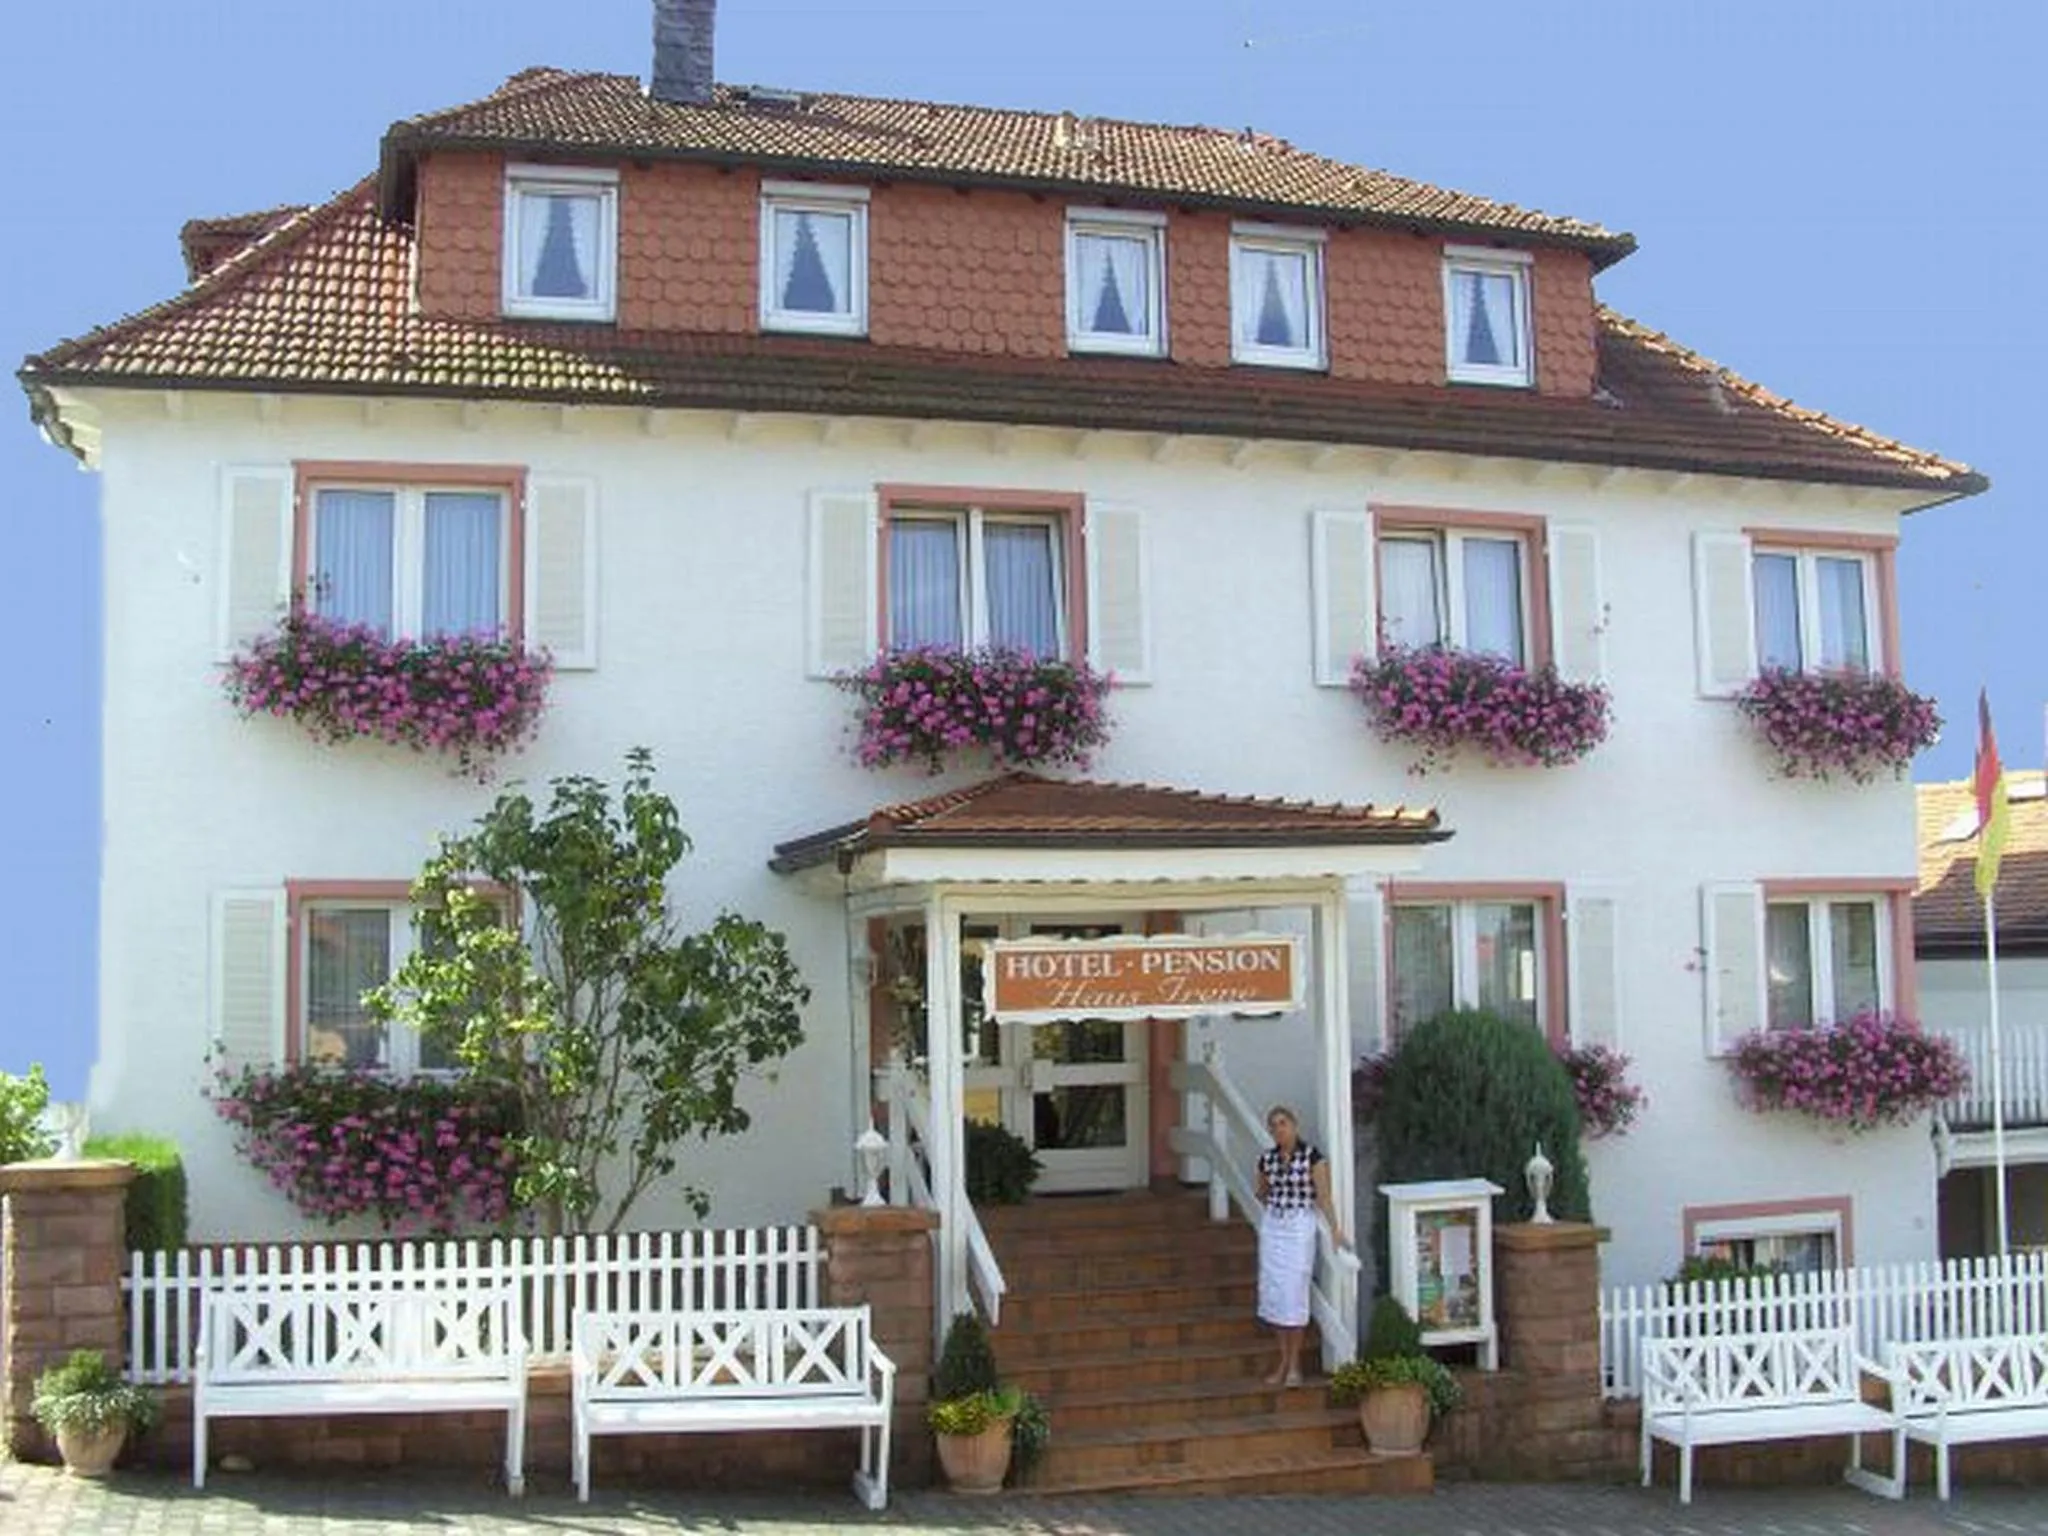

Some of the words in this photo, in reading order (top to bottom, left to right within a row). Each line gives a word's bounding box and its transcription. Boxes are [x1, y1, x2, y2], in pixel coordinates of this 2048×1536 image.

[1005, 952, 1123, 979] HOTEL
[1142, 948, 1283, 974] PENSION
[1046, 978, 1141, 1006] Haus
